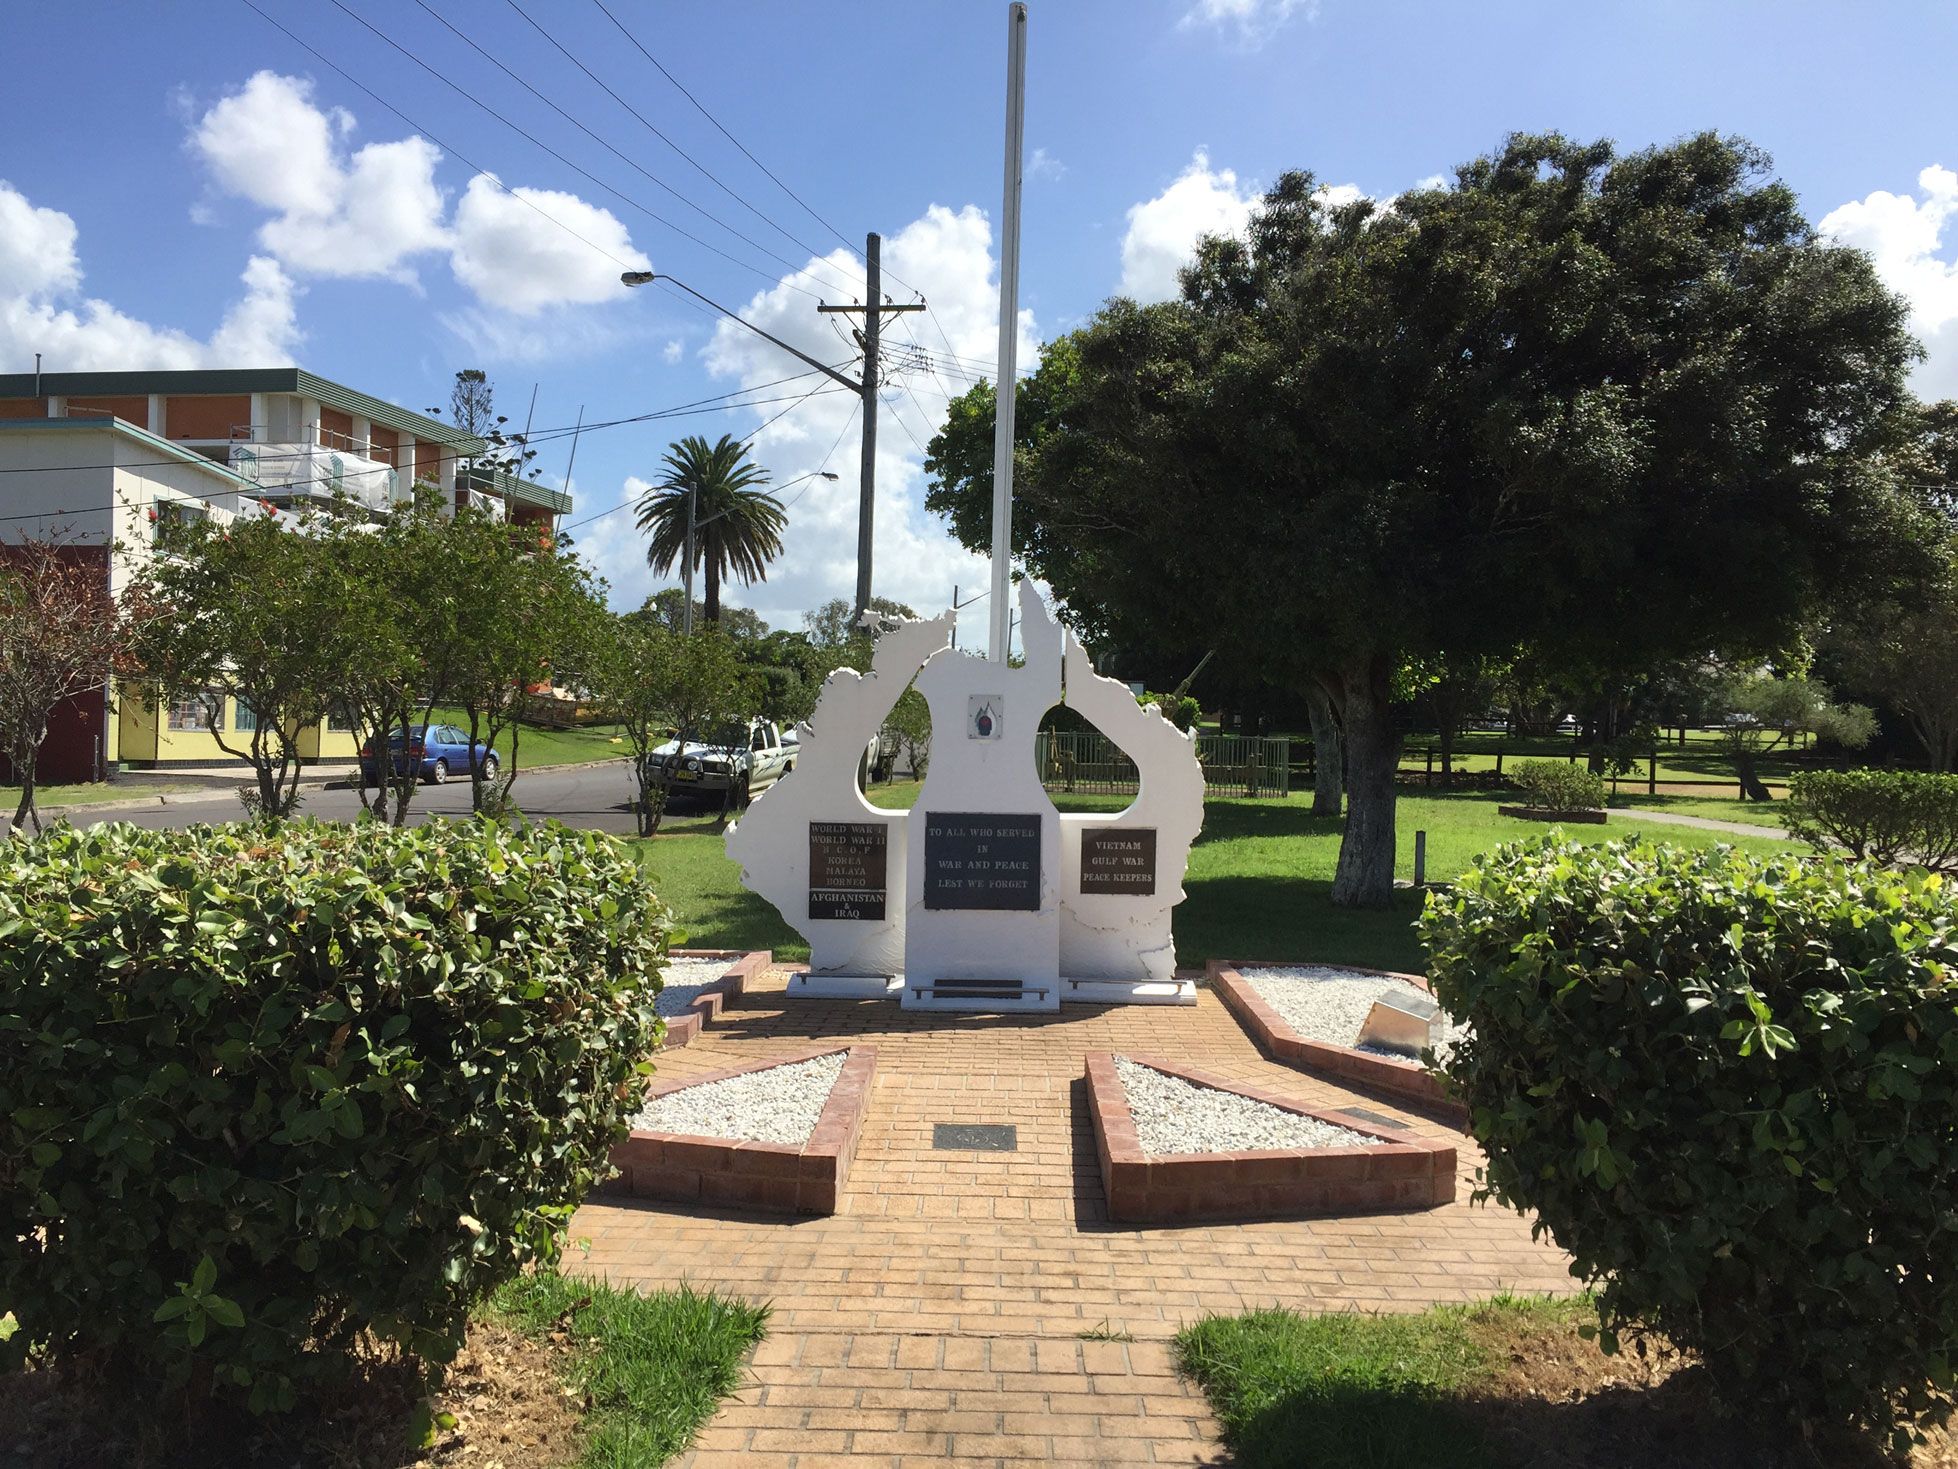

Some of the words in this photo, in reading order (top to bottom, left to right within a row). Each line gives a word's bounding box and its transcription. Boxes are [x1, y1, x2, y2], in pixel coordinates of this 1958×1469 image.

[811, 825, 846, 833] WORLD
[851, 825, 873, 834] WAR
[929, 828, 942, 836] TO
[946, 828, 965, 837] ALL
[970, 828, 993, 837] WHO
[997, 829, 1035, 837] SERVED
[810, 835, 846, 844] WORLD
[851, 836, 873, 844] WAR
[977, 845, 988, 853] IN
[1096, 842, 1141, 850] VIETNAM
[828, 856, 861, 865] KOREA
[1092, 857, 1118, 865] GULF
[1122, 857, 1144, 866] WAR
[939, 861, 962, 869] WAR
[967, 861, 990, 869] AND
[994, 861, 1029, 870] PEACE
[826, 867, 866, 875] MALAYA
[826, 878, 866, 886] BORNEO
[1083, 873, 1110, 881] PEACE
[1113, 874, 1152, 882] KEEPERS
[938, 879, 963, 888] LEST
[968, 880, 984, 888] WE
[989, 880, 1028, 888] FORGET
[811, 893, 884, 902] AFGHANISTAN
[835, 910, 860, 919] IRAQ
